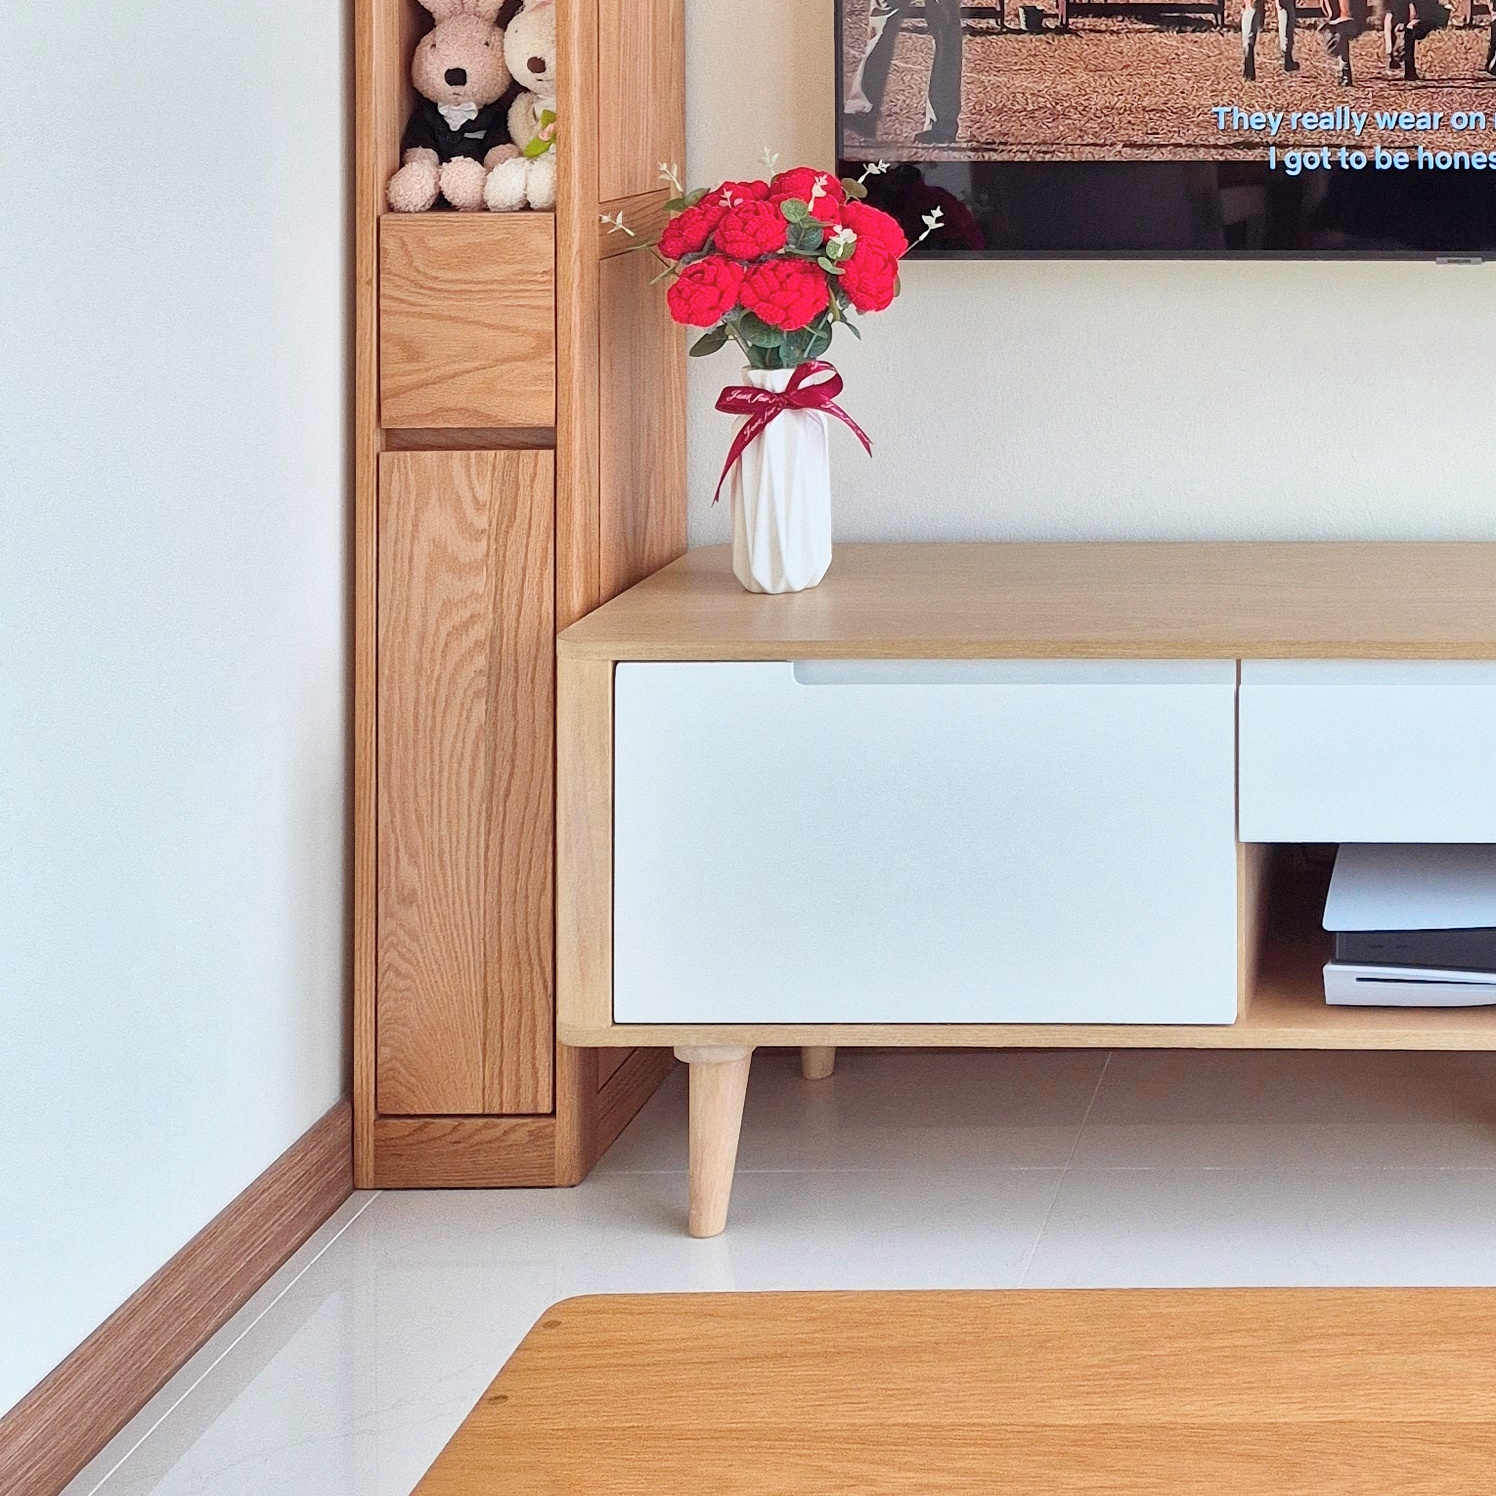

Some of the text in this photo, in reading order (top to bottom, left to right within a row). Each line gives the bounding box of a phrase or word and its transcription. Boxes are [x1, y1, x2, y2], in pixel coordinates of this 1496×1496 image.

[1212, 107, 1284, 135] They
[1291, 106, 1368, 136] really
[1375, 111, 1444, 130] wear
[1451, 110, 1486, 130] on
[1269, 146, 1276, 170] I
[1284, 147, 1332, 176] got
[1339, 147, 1367, 170] to
[1375, 146, 1410, 170] be
